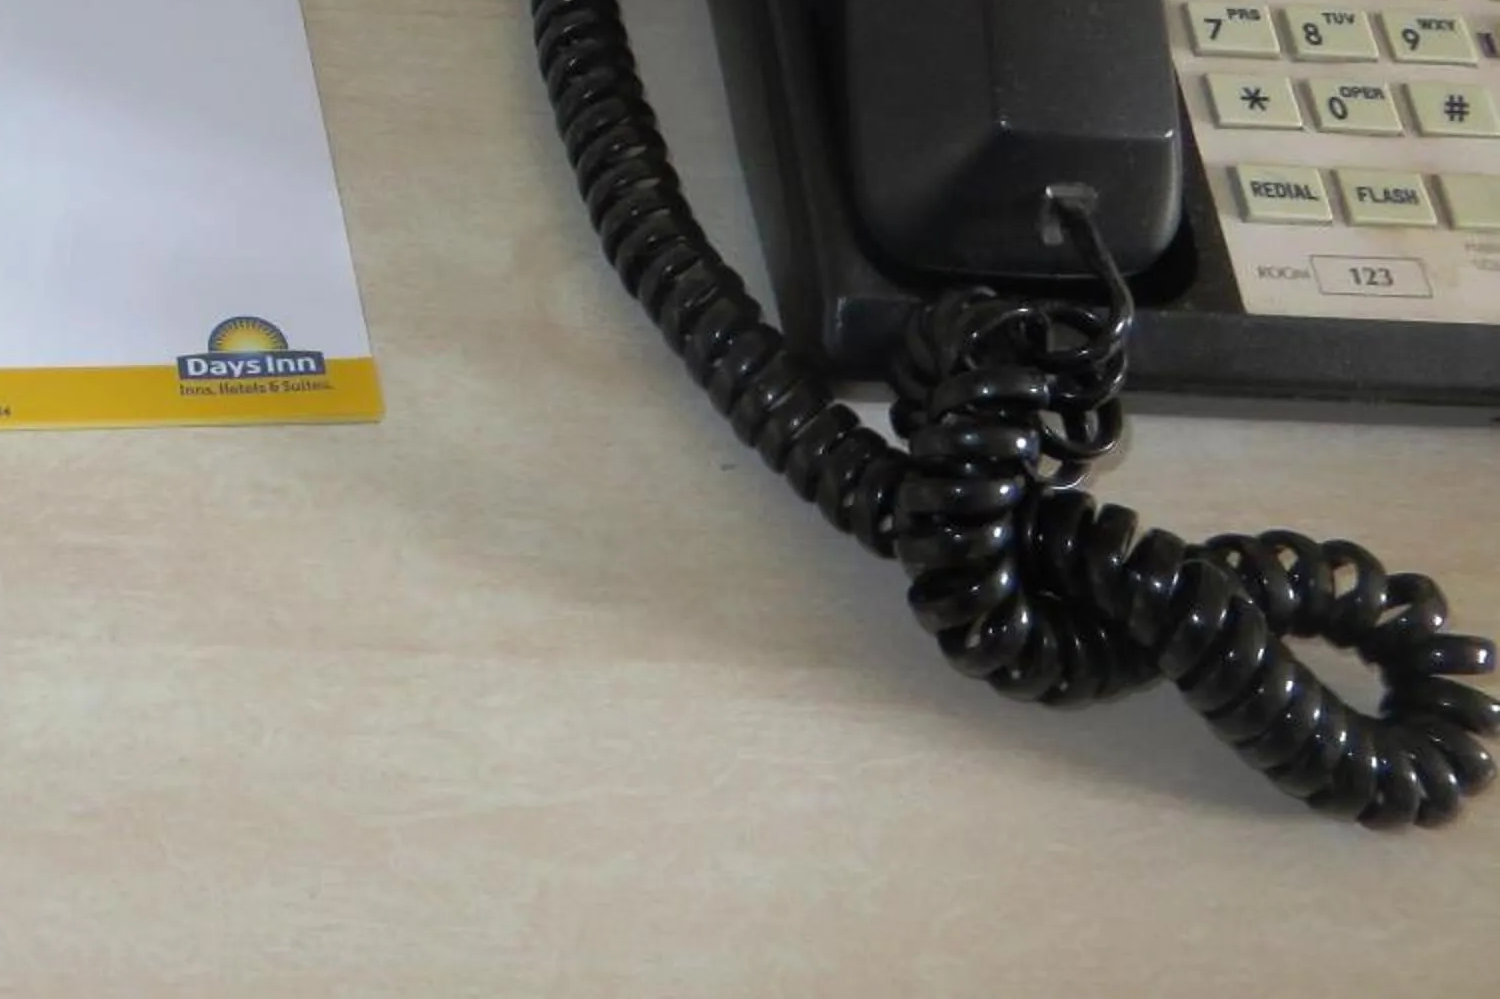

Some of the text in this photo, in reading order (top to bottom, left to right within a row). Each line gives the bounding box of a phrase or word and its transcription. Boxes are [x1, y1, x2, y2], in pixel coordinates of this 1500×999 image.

[1204, 8, 1261, 40] 7 PRS
[1303, 12, 1356, 46] 8 TUV
[1401, 27, 1421, 51] 9
[1328, 85, 1384, 121] 0 OPER
[1251, 180, 1319, 203] REDIAL
[1357, 185, 1418, 206] FLASH
[1348, 264, 1395, 288] 123
[186, 354, 317, 378] Days Inn
